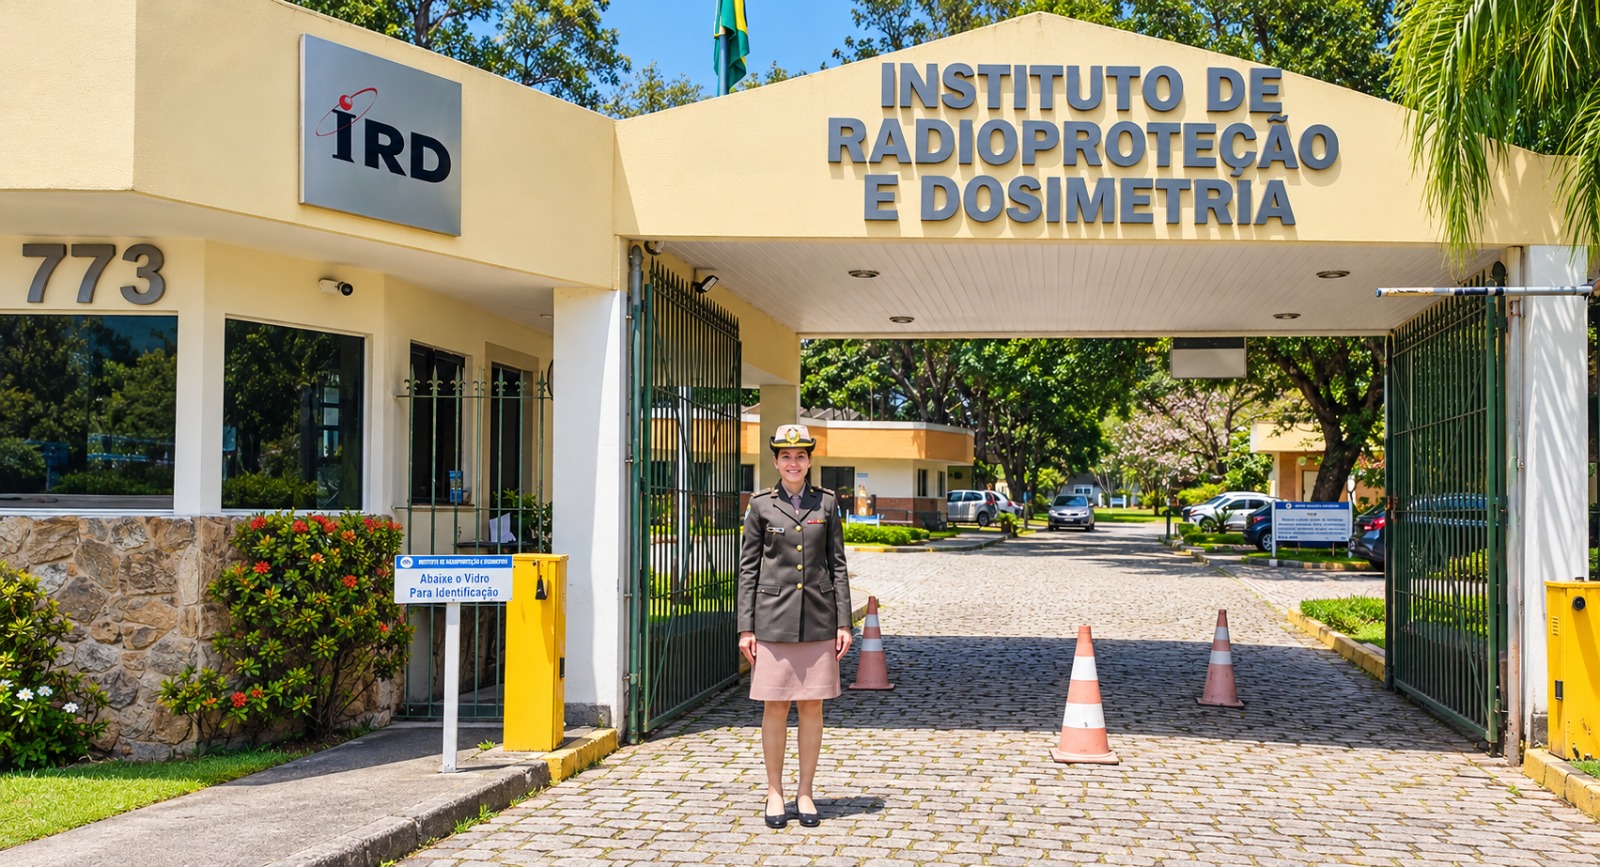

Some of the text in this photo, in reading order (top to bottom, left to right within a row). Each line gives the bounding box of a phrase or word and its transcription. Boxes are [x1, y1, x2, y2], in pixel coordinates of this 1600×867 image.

[880, 62, 1283, 113] INSTITUTO DE
[827, 114, 1340, 176] RADIOPROTEÇÃO
[863, 174, 1296, 226] E DOSIMETRIA
[22, 243, 166, 305] 773
[410, 586, 499, 600] Para Identificação
[420, 573, 490, 584] Abaixe o Vidro
